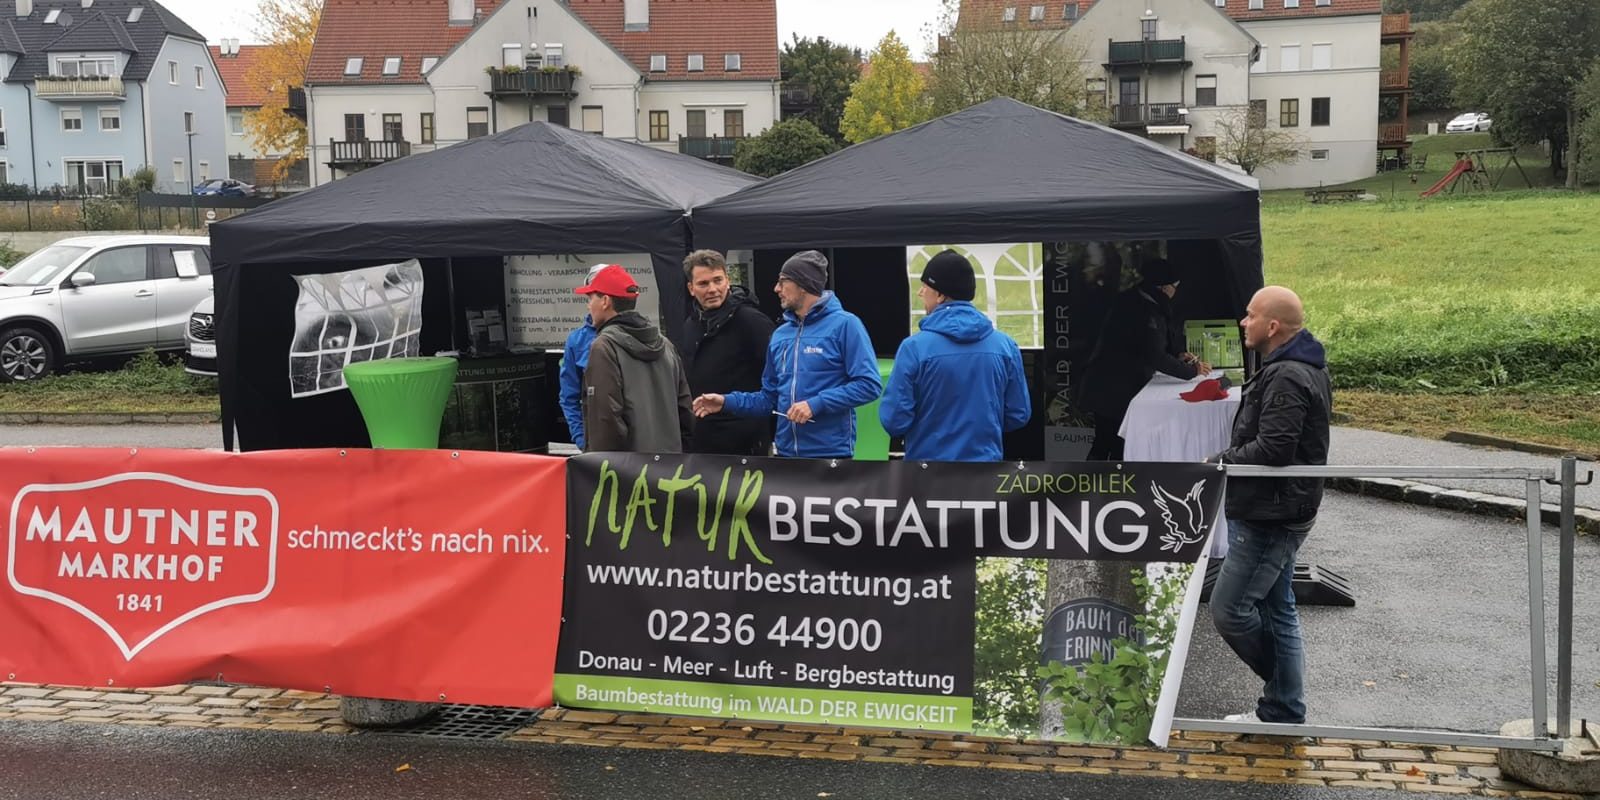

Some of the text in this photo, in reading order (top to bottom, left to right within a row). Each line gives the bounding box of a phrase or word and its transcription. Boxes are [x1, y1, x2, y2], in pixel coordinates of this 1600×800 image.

[1052, 241, 1070, 419] WALD DER EWIG
[996, 473, 1136, 494] ZADROBILEK
[25, 506, 260, 548] MAUTNER
[585, 459, 1149, 565] NATUR BESTATTUNG
[430, 528, 494, 553] nach
[502, 528, 550, 555] nix.
[57, 551, 225, 583] MARKHOF
[587, 563, 952, 606] www.naturbestattung.at
[115, 593, 164, 613] 1841
[1066, 610, 1112, 633] BAUM
[647, 608, 882, 652] 02236 44900
[1065, 636, 1113, 663] ERINN
[579, 651, 643, 672] Donau
[663, 655, 713, 677] Meer
[735, 660, 774, 680] Luft
[795, 663, 955, 695] Bergbestattung
[576, 684, 958, 725] Baumbestattung im WALD DER EWIGKEIT
